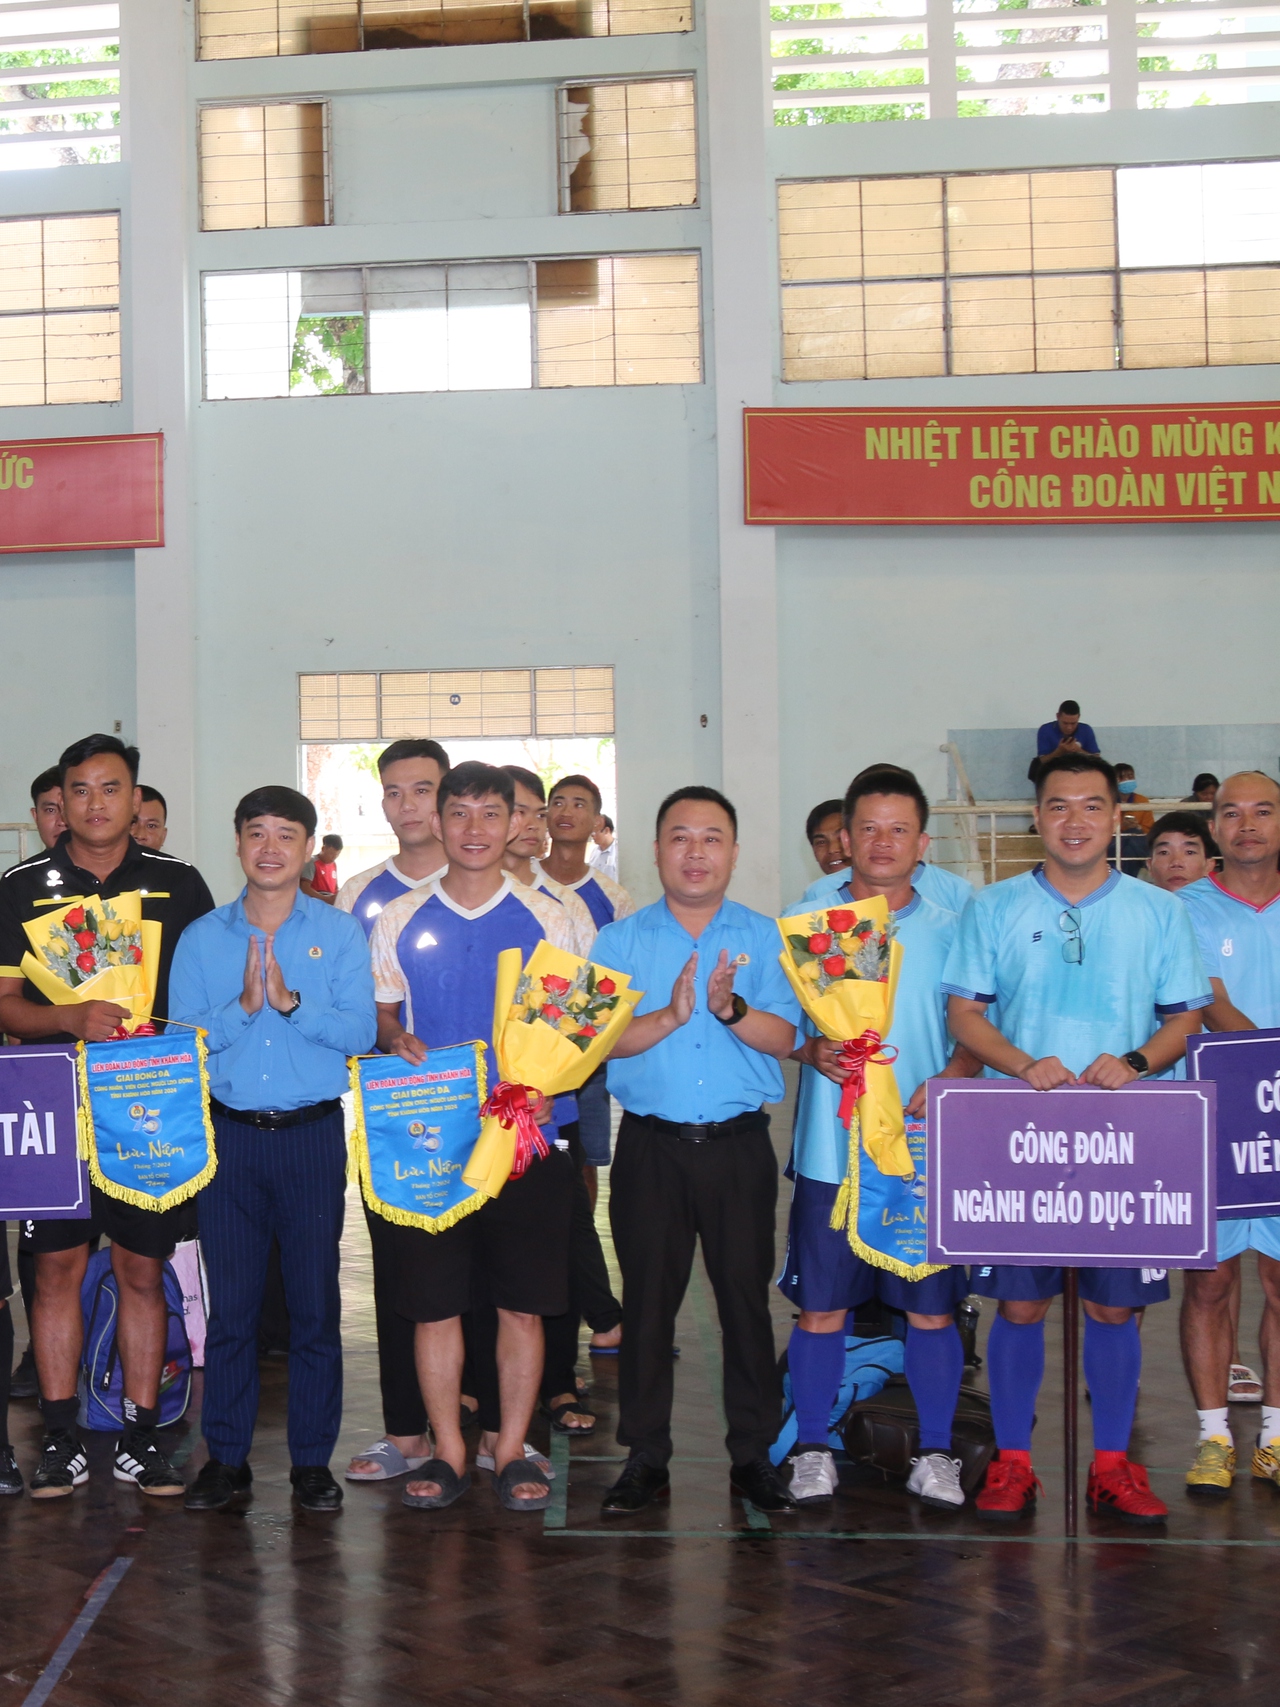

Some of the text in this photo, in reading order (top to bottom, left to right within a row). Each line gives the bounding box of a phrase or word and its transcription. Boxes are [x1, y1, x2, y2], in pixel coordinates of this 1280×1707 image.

[866, 420, 961, 467] NHIỆT
[973, 419, 1039, 467] LIỆT
[1050, 418, 1139, 459] CHÀO
[1152, 416, 1253, 457] MỪNG
[969, 468, 1061, 509] CÔNG
[1072, 468, 1165, 507] ĐOÀN
[1175, 465, 1247, 513] VIỆT
[1009, 1121, 1135, 1165] CÔNG ĐOÀN
[953, 1180, 1025, 1223] NGÀNH
[1033, 1181, 1083, 1224] GIÁO
[1090, 1190, 1135, 1231] DỤC
[1140, 1179, 1192, 1226] TỈNH
